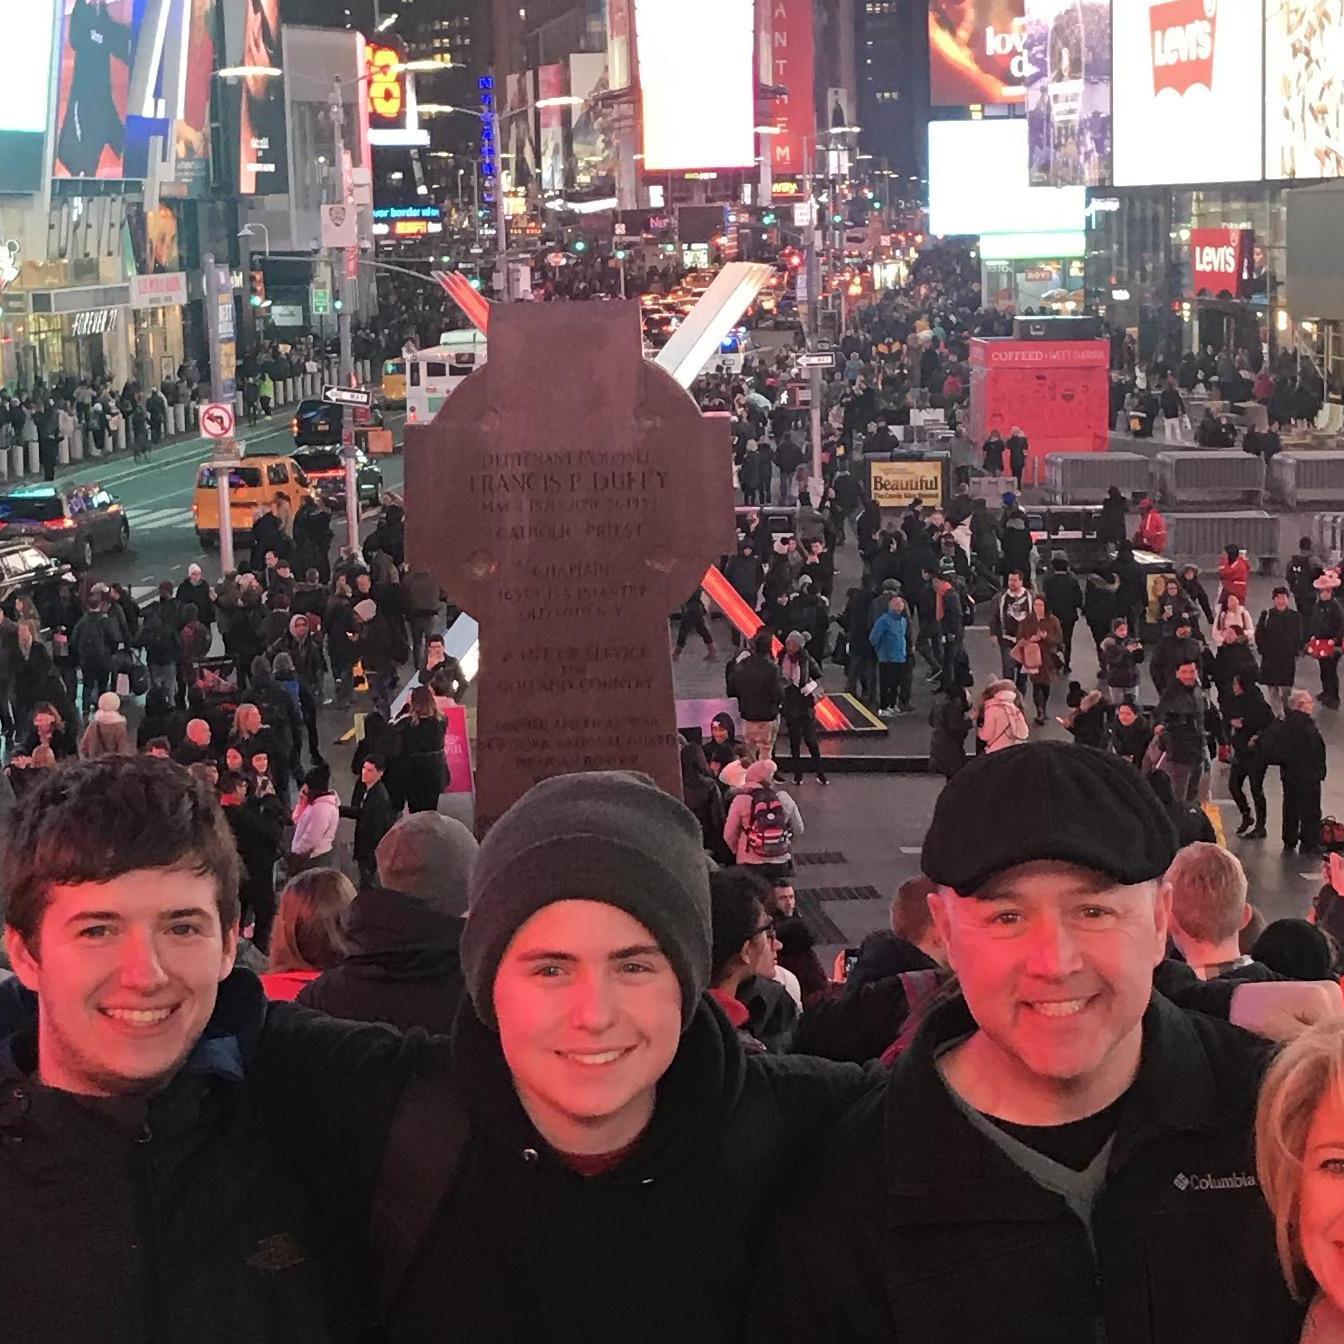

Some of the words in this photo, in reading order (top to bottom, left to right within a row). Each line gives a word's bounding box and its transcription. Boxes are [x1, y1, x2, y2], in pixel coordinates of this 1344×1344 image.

[71, 310, 107, 337] FOREVER
[108, 309, 118, 332] 21
[350, 393, 364, 401] WAY
[469, 471, 563, 494] FRANCIS
[593, 469, 669, 492] DUFFY
[873, 475, 939, 491] Beautiful
[1190, 1171, 1257, 1190] Columbia
